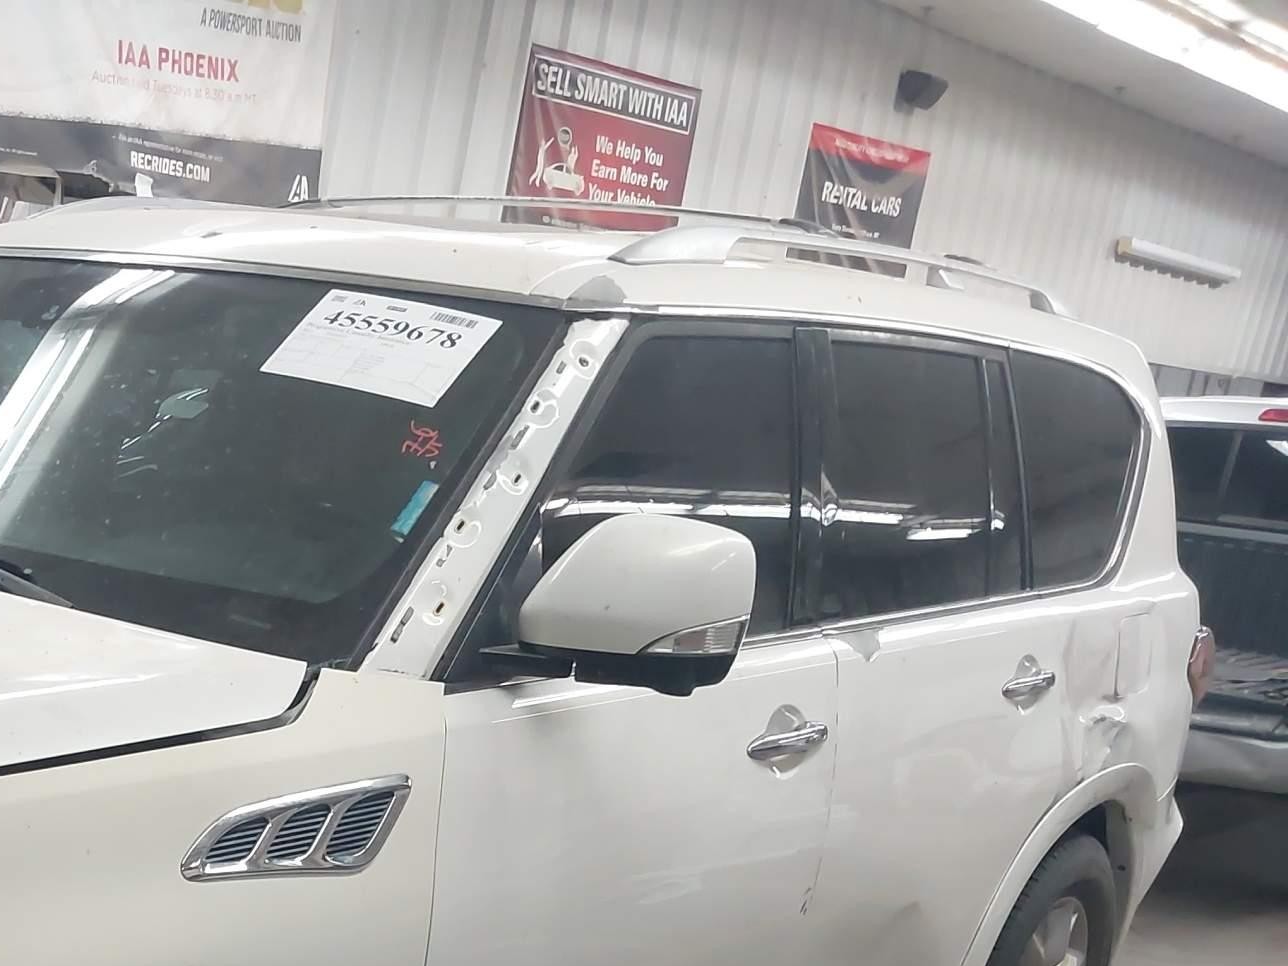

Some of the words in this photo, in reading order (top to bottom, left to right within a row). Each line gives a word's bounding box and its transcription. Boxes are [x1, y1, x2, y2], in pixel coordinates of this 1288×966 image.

[200, 8, 207, 26] A
[209, 9, 262, 37] POWERSPORT
[265, 20, 301, 43] AUCTION
[118, 40, 150, 70] IAA
[158, 47, 239, 82] PHOENIX
[537, 63, 571, 98] SELL
[574, 73, 627, 111] SMART
[628, 88, 664, 121] WITH
[664, 99, 688, 127] IAA
[130, 150, 210, 182] RECRIDES.COM
[596, 135, 613, 155] We
[616, 139, 641, 165] Help
[645, 146, 664, 167] You
[588, 182, 614, 202] Your
[591, 159, 617, 180] Earn
[619, 165, 648, 187] More
[650, 172, 669, 192] For
[821, 181, 867, 211] RENTAL
[872, 196, 902, 217] CARS
[323, 310, 462, 349] 45559678
